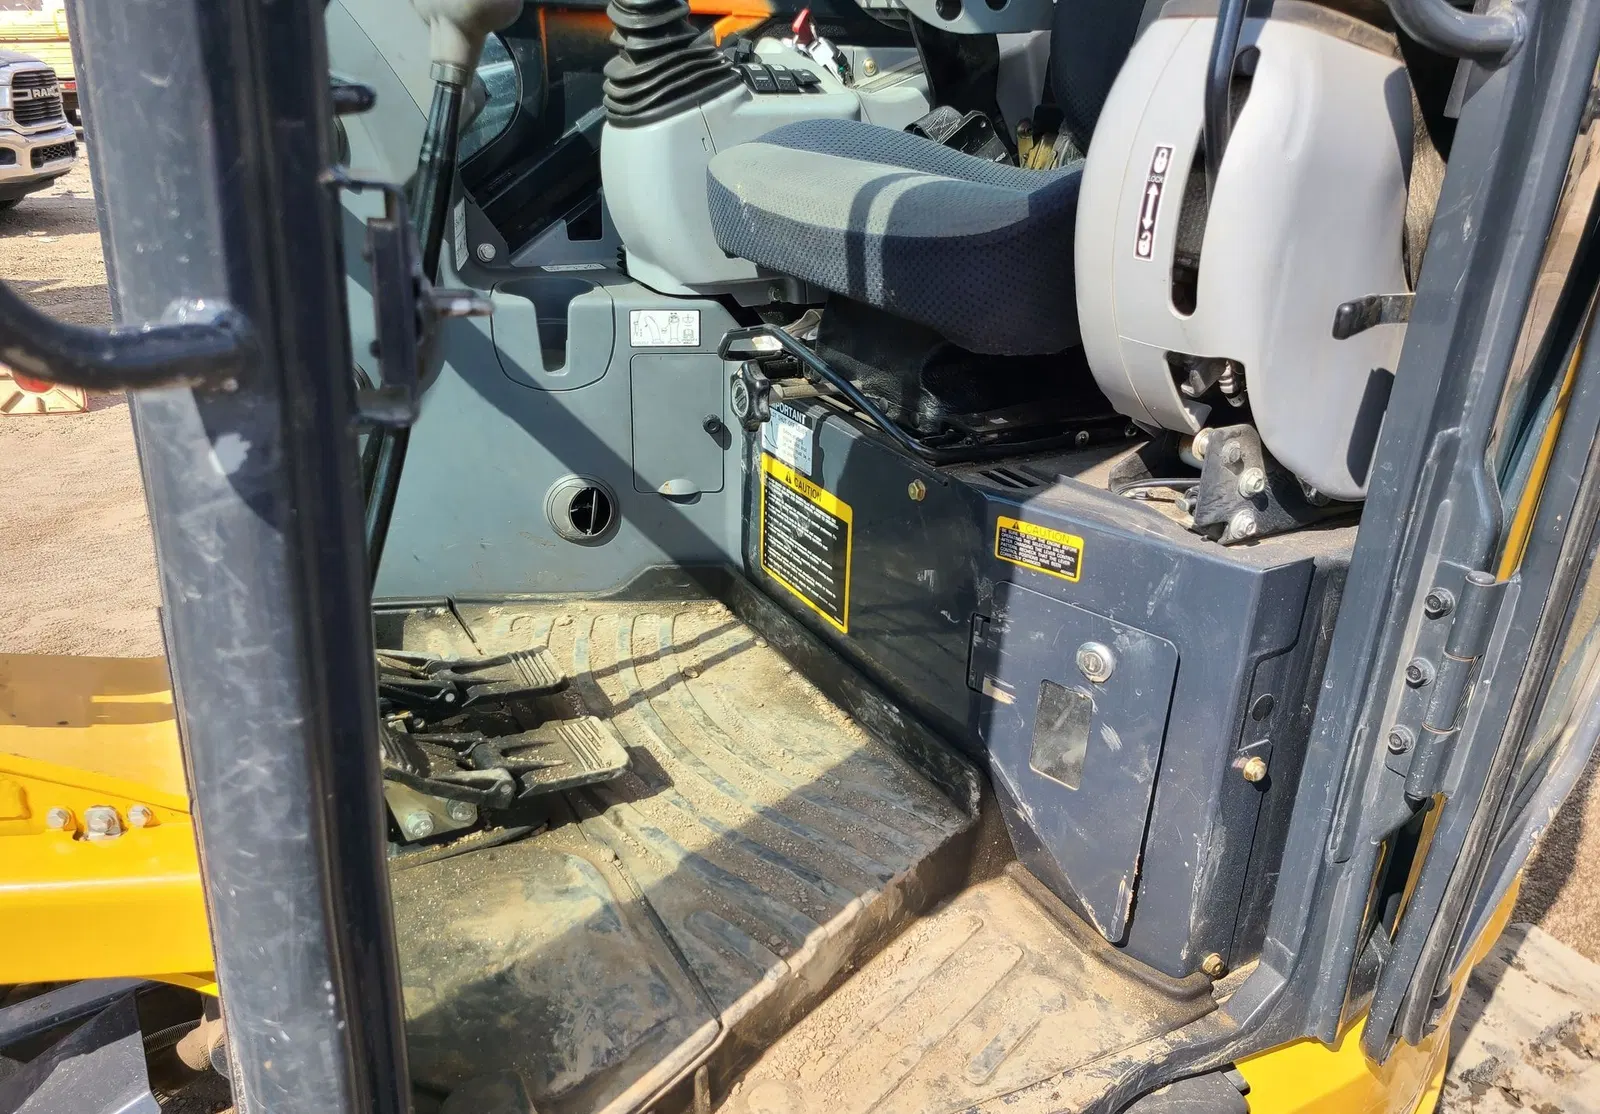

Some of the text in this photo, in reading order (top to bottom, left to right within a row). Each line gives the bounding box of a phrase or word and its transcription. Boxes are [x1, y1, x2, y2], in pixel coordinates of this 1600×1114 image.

[32, 86, 56, 98] RAM
[1147, 176, 1164, 184] LOCK
[771, 401, 807, 425] PORTANT
[794, 477, 822, 503] CAUTION
[1025, 524, 1070, 544] CAUTION
